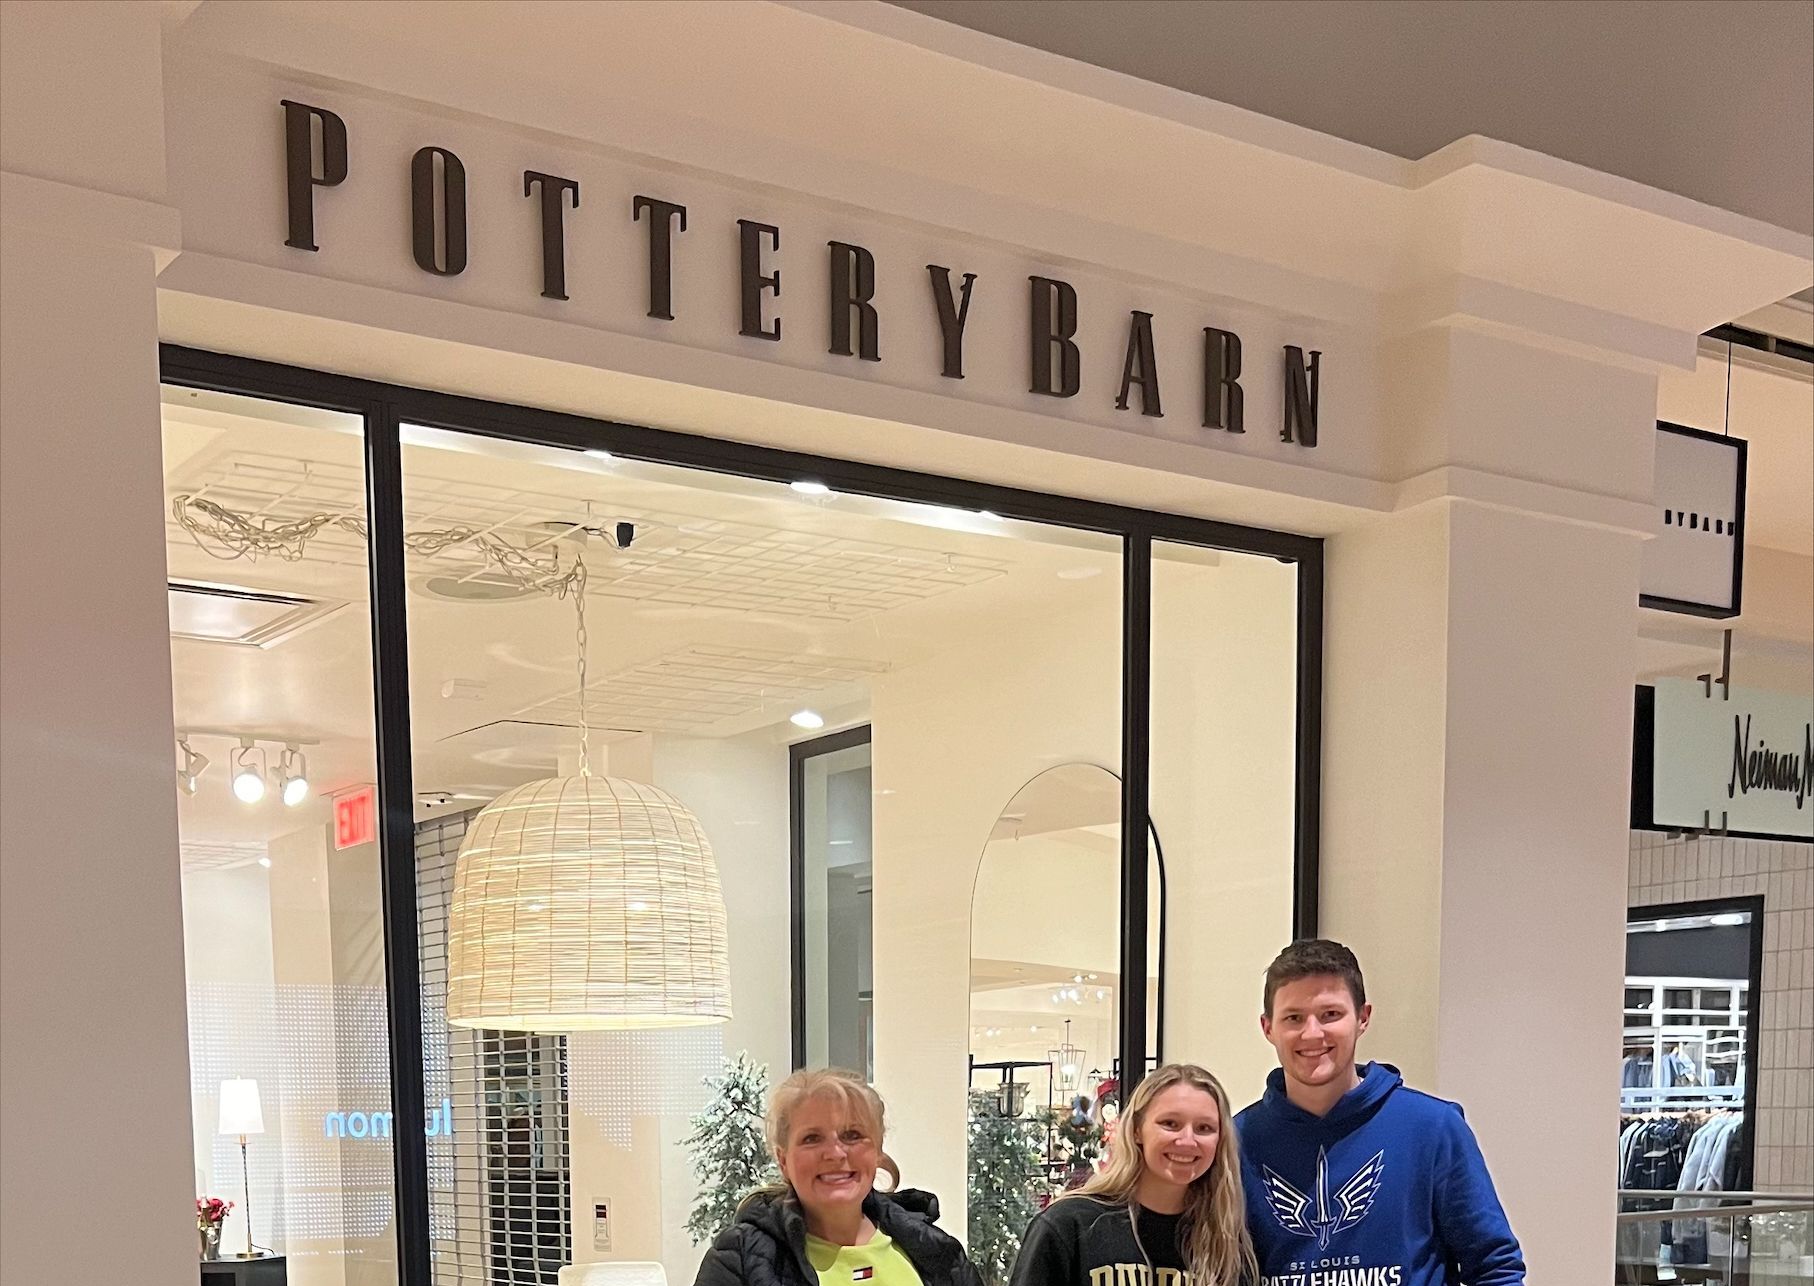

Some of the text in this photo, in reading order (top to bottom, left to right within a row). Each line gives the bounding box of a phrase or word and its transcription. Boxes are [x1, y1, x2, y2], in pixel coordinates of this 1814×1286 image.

[280, 99, 1321, 447] POTTERY BARN
[1728, 713, 1801, 799] Neiman
[1310, 1255, 1361, 1269] LOUIS
